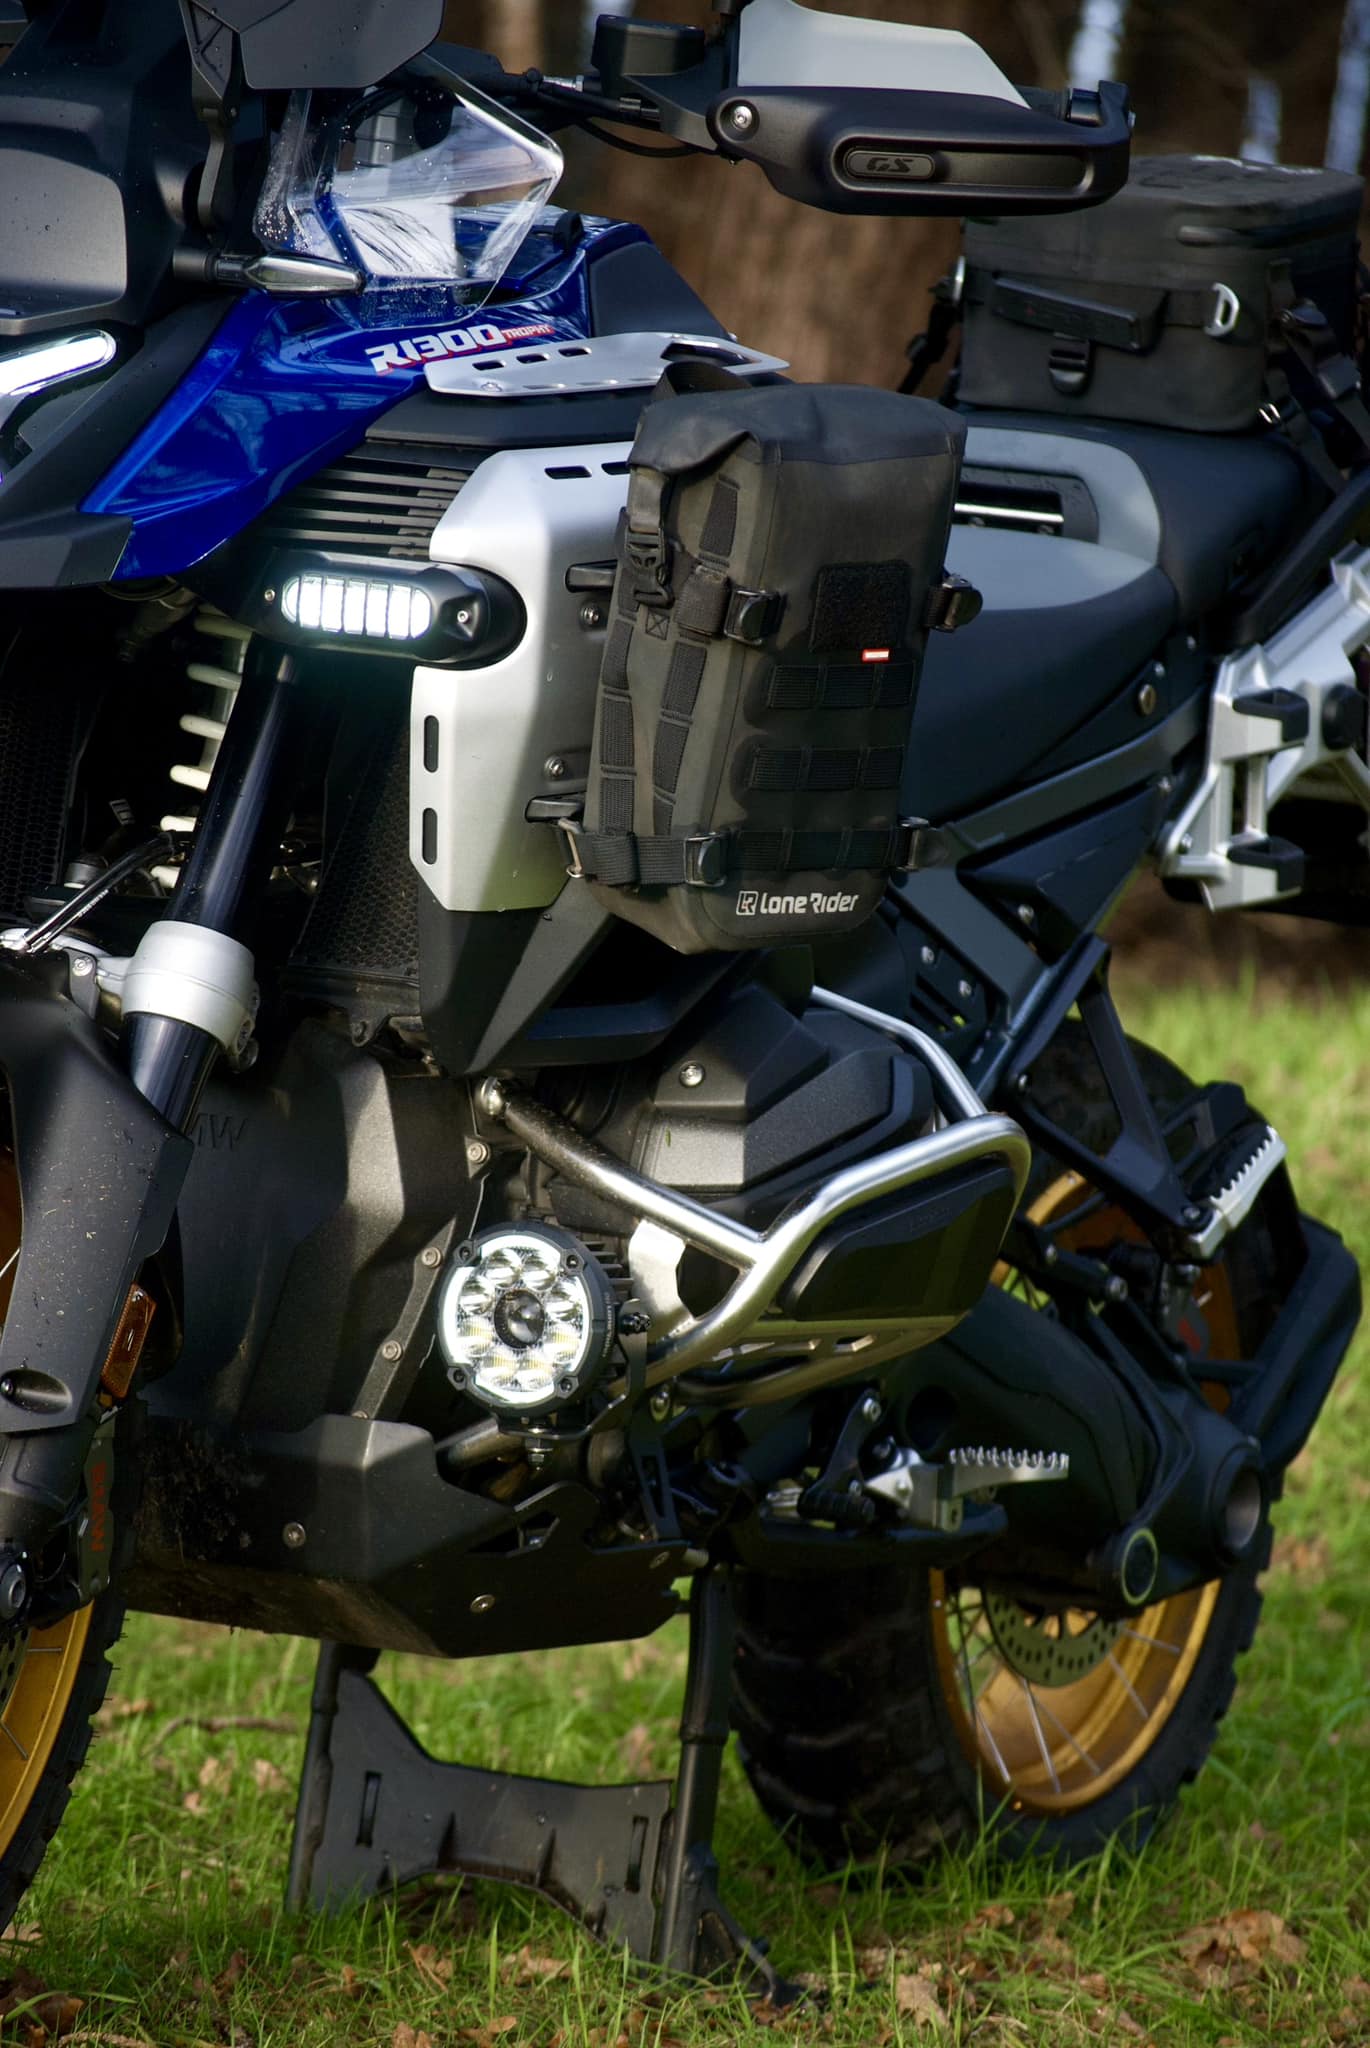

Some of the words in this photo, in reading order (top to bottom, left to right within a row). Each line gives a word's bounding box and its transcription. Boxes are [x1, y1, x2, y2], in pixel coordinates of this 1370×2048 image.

[866, 157, 914, 174] GS
[365, 324, 507, 375] R1300
[502, 325, 555, 344] TROPHY
[760, 892, 808, 914] Lone
[809, 891, 860, 914] Rider
